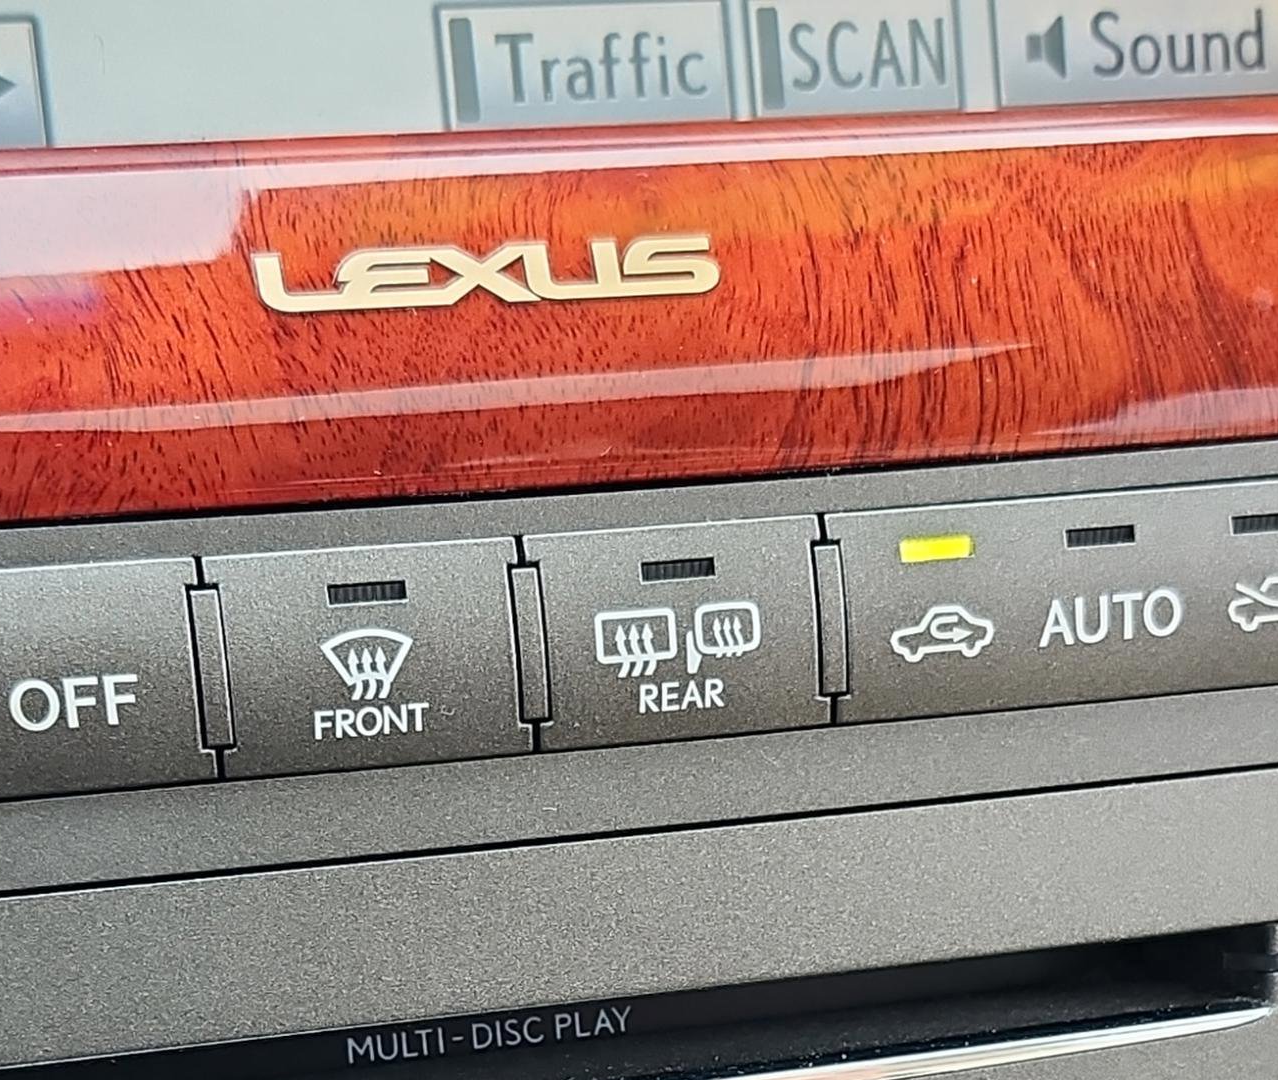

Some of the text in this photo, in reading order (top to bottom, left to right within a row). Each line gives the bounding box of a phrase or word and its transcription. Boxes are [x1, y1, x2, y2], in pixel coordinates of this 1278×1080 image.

[493, 30, 708, 104] Traffic
[790, 17, 949, 92] SCAN
[1090, 6, 1266, 79] Sound
[252, 234, 722, 313] LEXUS
[1039, 588, 1182, 648] AUTO
[9, 673, 139, 732] OFF
[314, 702, 430, 741] FRONT
[638, 677, 726, 714] REAR
[554, 1006, 634, 1041] PLAY
